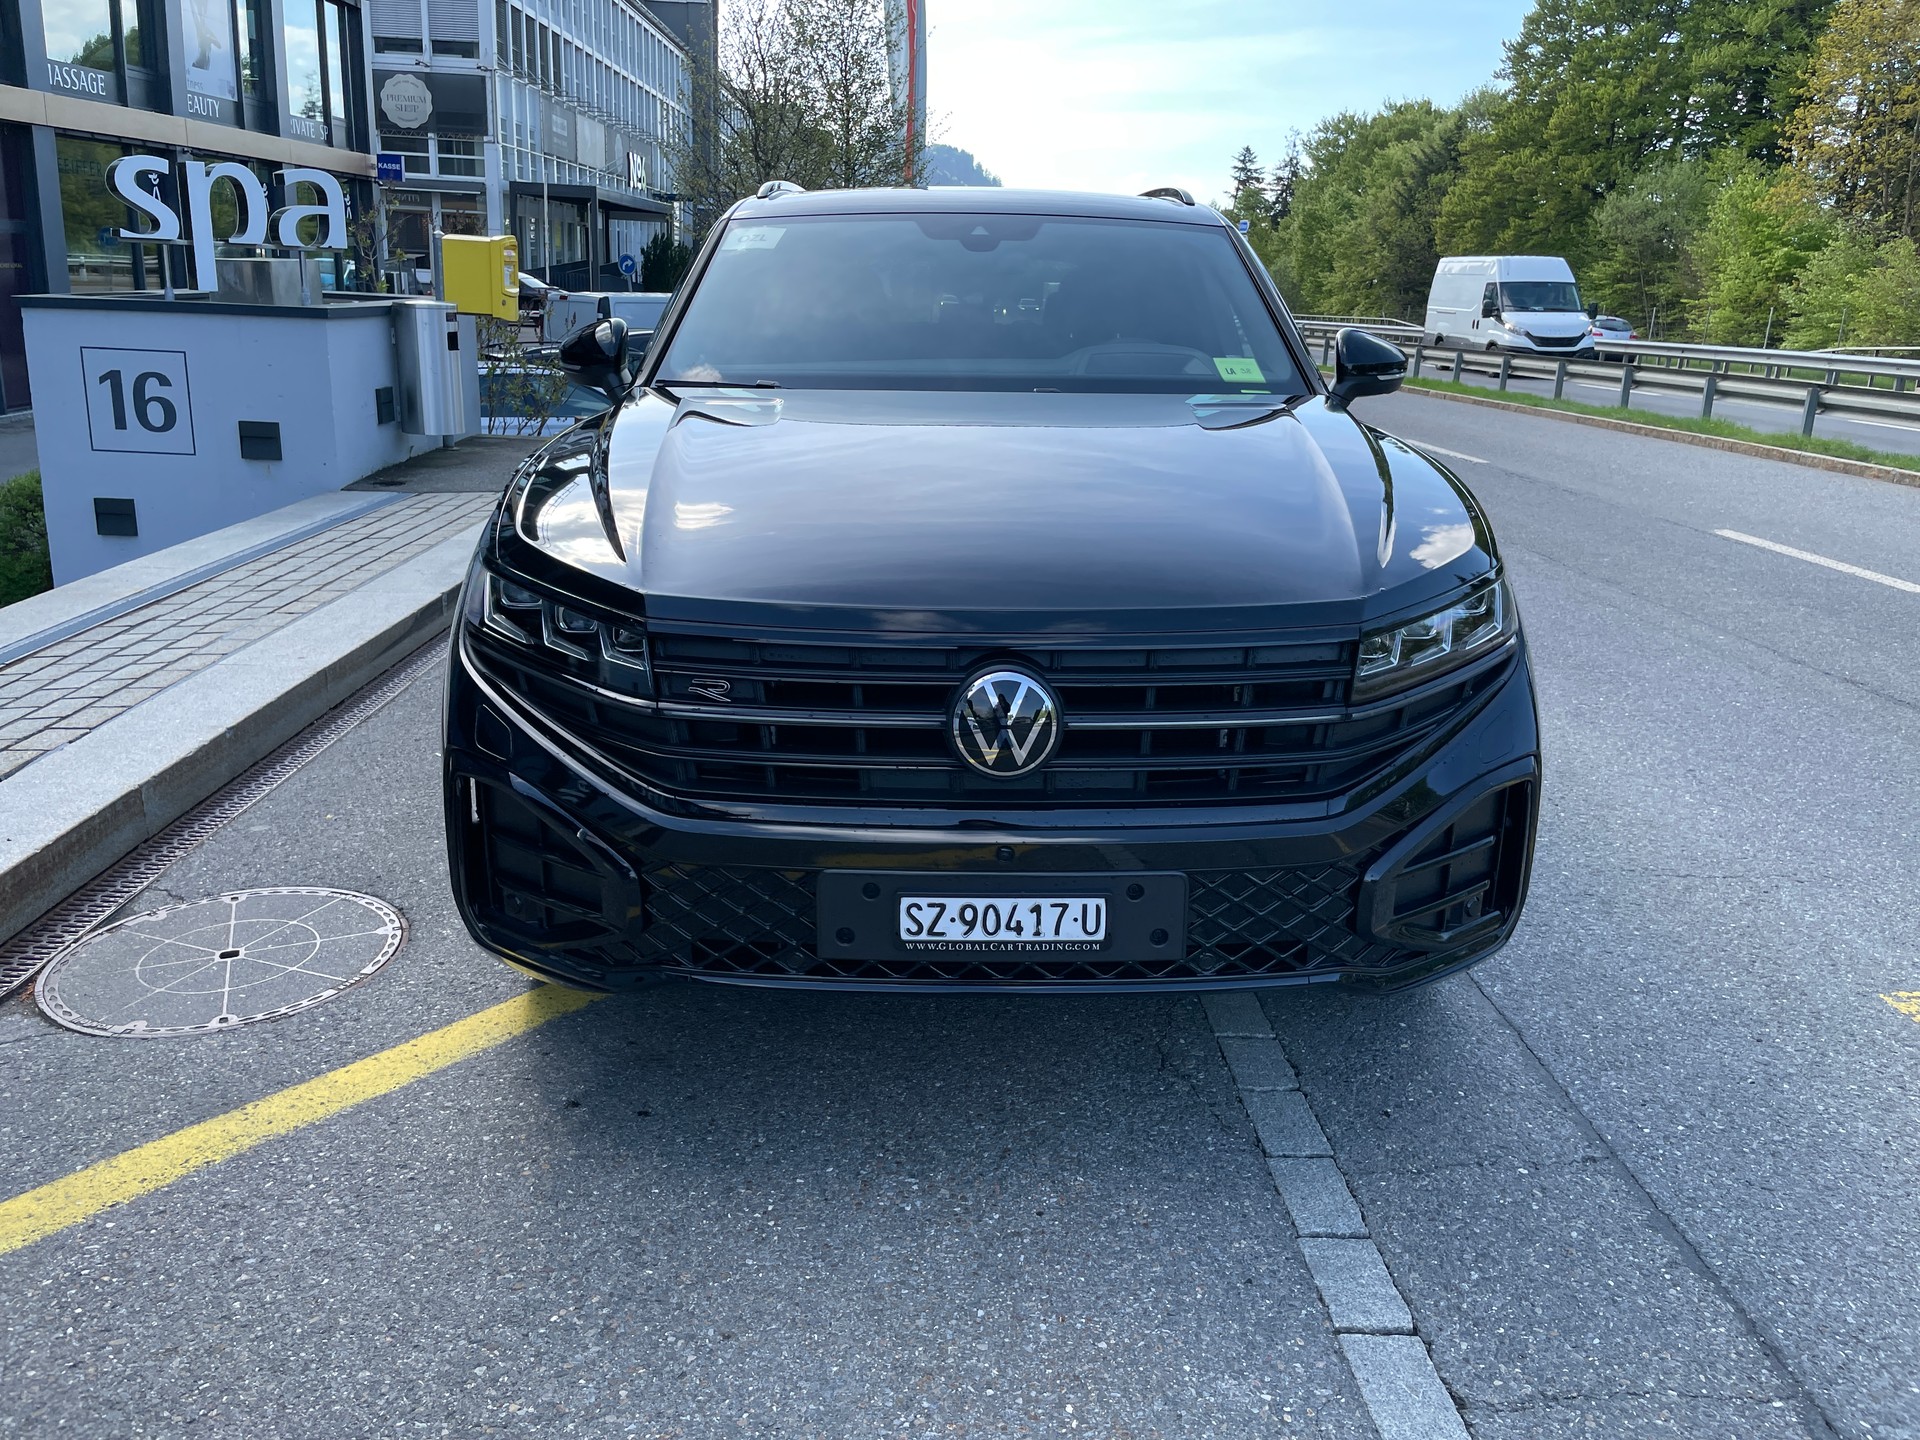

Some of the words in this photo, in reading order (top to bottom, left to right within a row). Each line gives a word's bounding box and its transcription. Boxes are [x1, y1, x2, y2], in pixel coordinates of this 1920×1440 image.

[386, 94, 427, 104] PREMIUM
[290, 119, 315, 138] IVATE
[378, 162, 401, 170] KASSE
[105, 155, 347, 292] spa
[98, 369, 177, 433] 16
[688, 678, 731, 702] R
